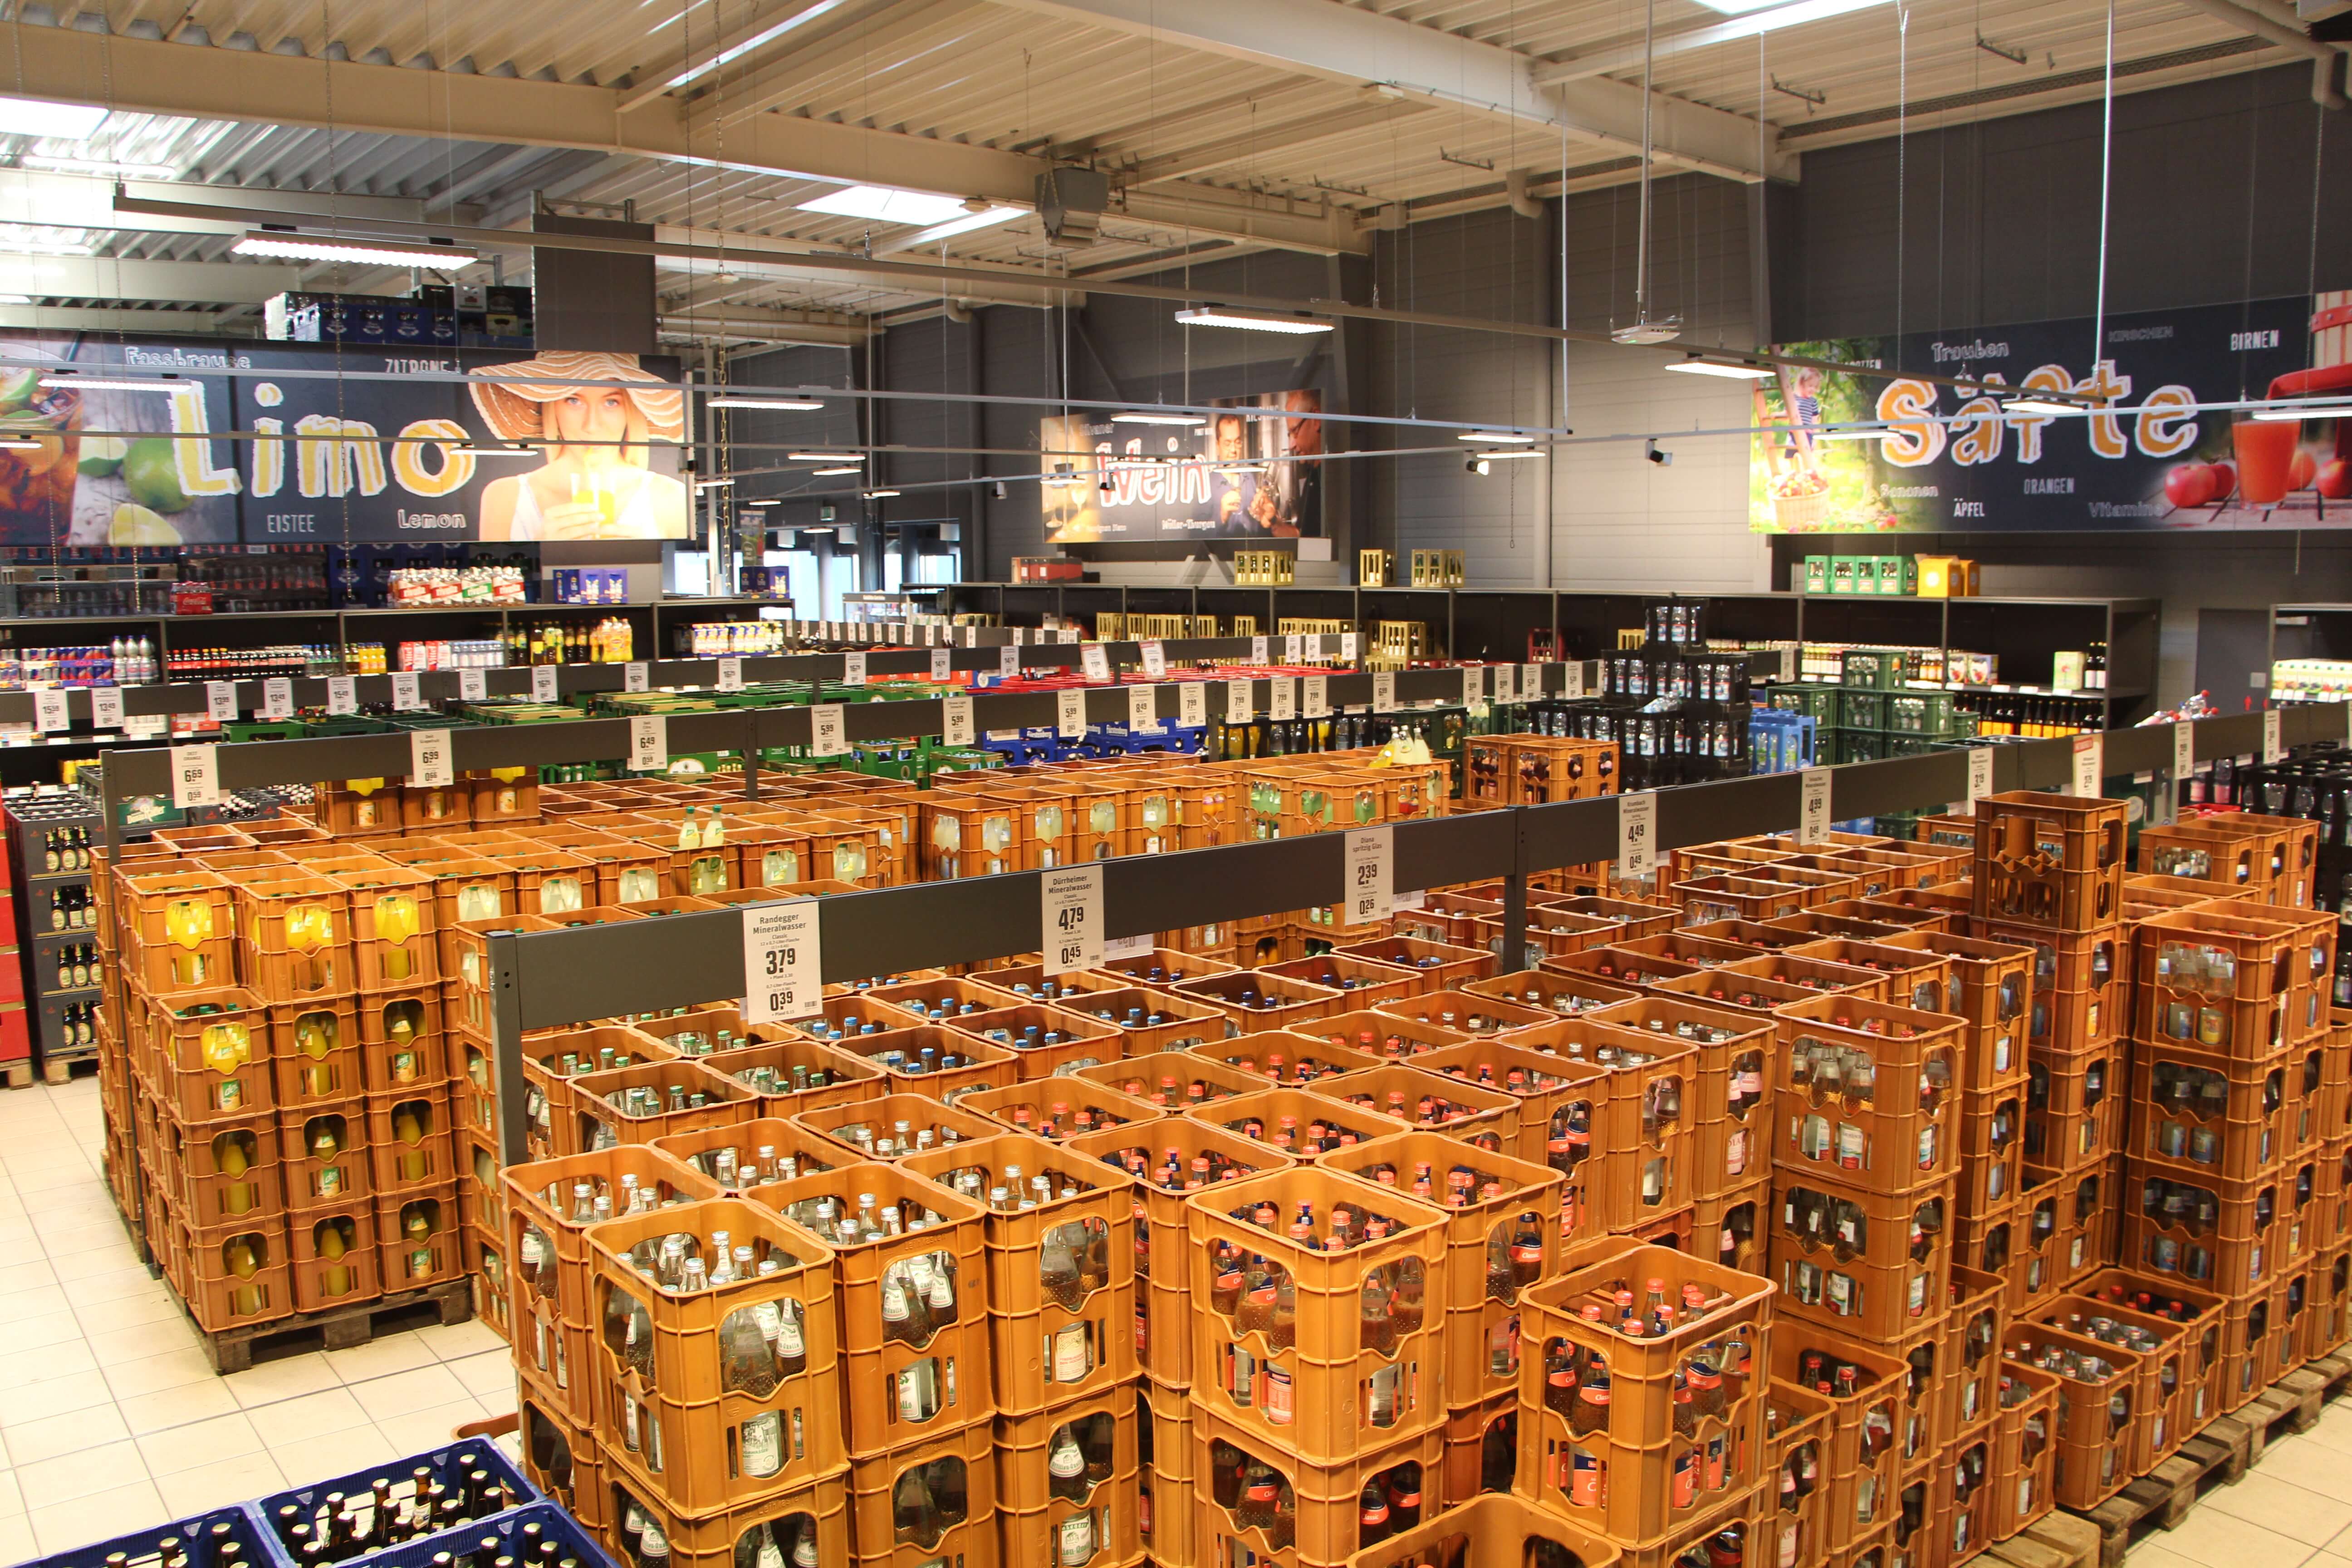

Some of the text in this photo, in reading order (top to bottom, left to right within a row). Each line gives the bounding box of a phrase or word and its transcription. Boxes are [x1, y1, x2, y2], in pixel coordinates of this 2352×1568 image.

[2231, 329, 2279, 351] BIRNEN
[125, 346, 251, 370] Fassbrause
[1931, 339, 2009, 363] Trauben
[1876, 359, 2199, 468] Säfte
[167, 379, 476, 498] Limo
[1095, 436, 1212, 508] Wein
[1880, 484, 1938, 499] Bananen
[2024, 478, 2075, 495] ORANGEN
[1954, 498, 1985, 517] ÄPFEL
[2089, 501, 2164, 518] Vitamine
[267, 514, 315, 533] EISTEE
[397, 509, 466, 529] Lemon
[951, 715, 964, 726] 5.99
[1065, 708, 1077, 718] 5.99
[820, 724, 834, 735] 5.99
[640, 736, 655, 749] 6.49
[422, 751, 439, 764] 6.99
[185, 769, 203, 782] 6.69
[1628, 824, 1644, 843] 4.49
[1352, 844, 1371, 853] spritzig
[1630, 855, 1642, 869] 0.49
[1053, 875, 1088, 886] Dürrheimer
[1357, 863, 1377, 886] 2.39
[1048, 883, 1093, 894] Mineralwasser
[1359, 898, 1375, 915] 0.26
[760, 913, 799, 925] Randegger
[1058, 906, 1084, 931] 4.79
[753, 921, 807, 935] Mineralwasser
[765, 948, 796, 975] 3.79
[1062, 946, 1081, 964] 0.45
[770, 991, 793, 1011] 0.39
[1690, 1377, 1707, 1386] Classic
